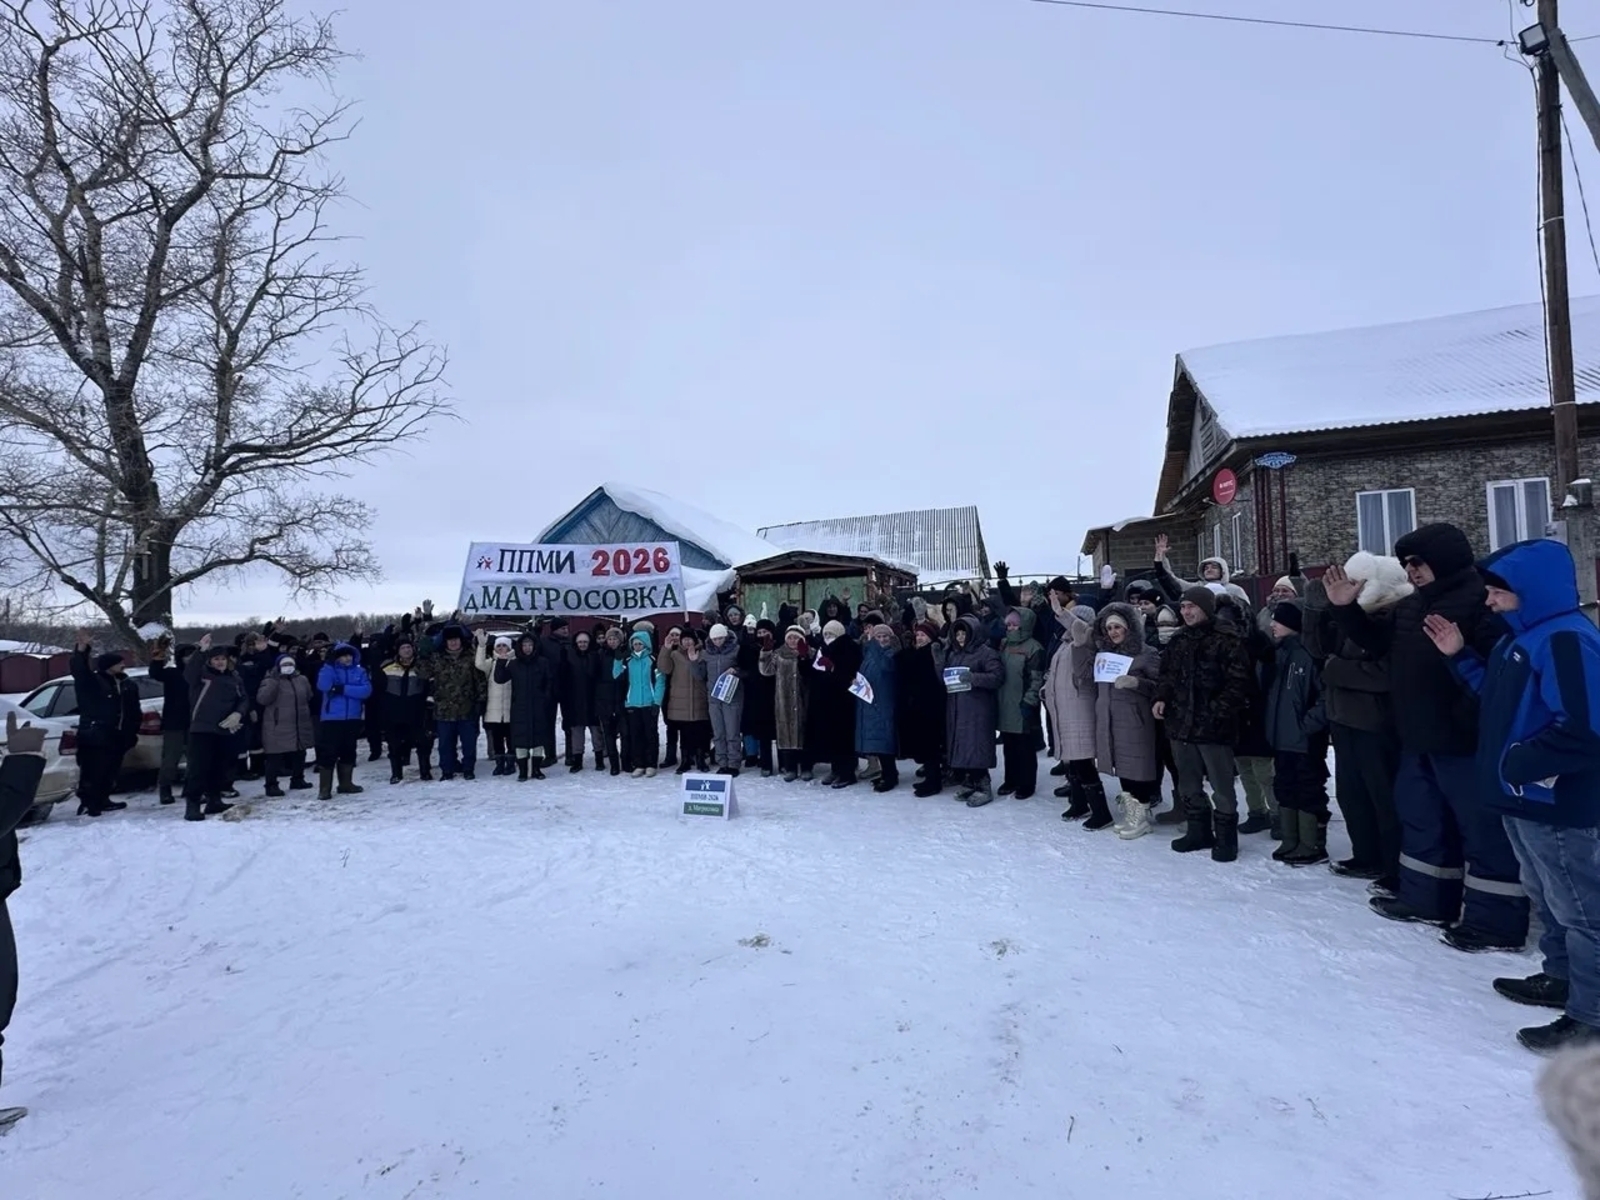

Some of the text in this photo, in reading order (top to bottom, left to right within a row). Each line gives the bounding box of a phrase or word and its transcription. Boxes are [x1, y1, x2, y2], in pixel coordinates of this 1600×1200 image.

[497, 547, 671, 577] ППМИ 2026
[481, 584, 681, 611] МАТРОСОВКА
